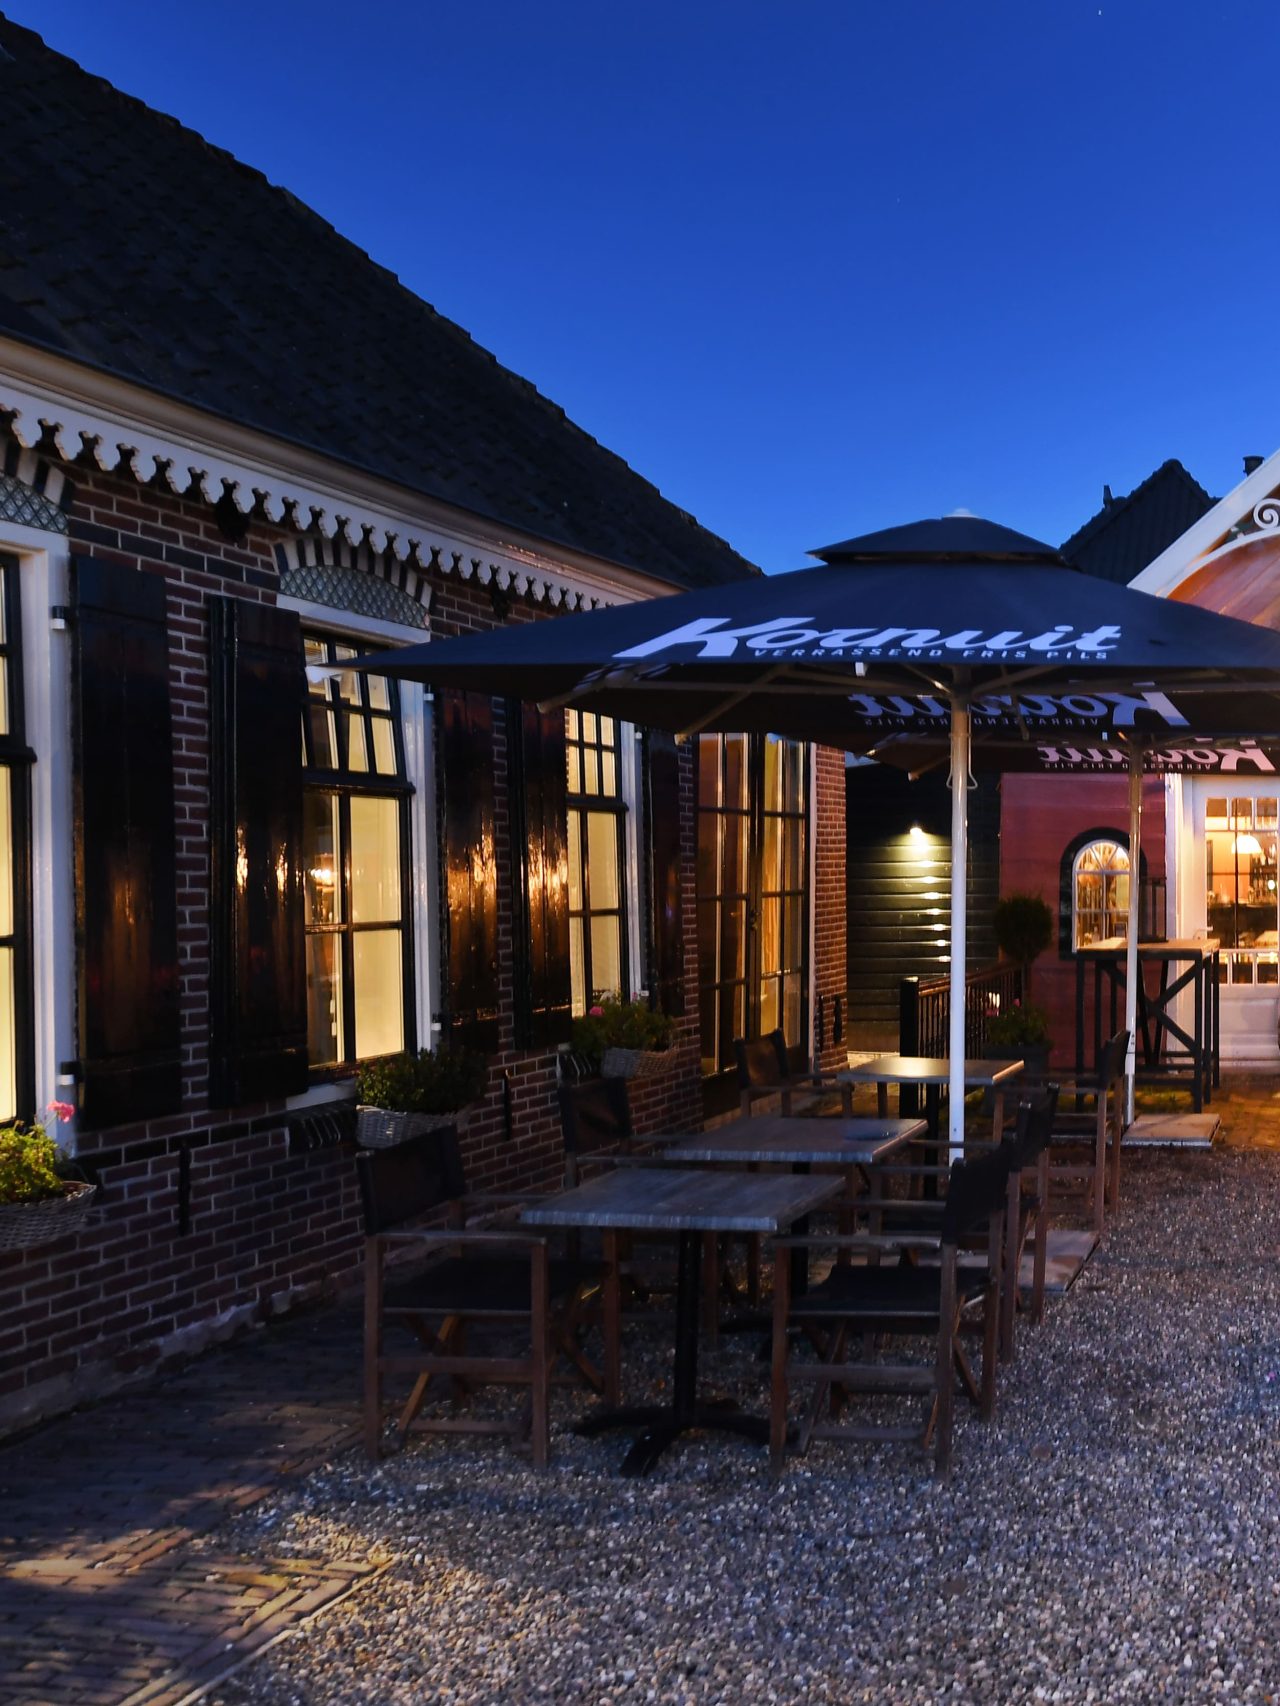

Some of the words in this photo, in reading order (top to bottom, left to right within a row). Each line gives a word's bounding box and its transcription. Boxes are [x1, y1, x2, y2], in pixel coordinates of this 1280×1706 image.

[612, 617, 1121, 658] Kornuit
[754, 648, 943, 657] VERRASSEND
[963, 649, 1026, 658] FRIS
[1046, 650, 1108, 658] PILS
